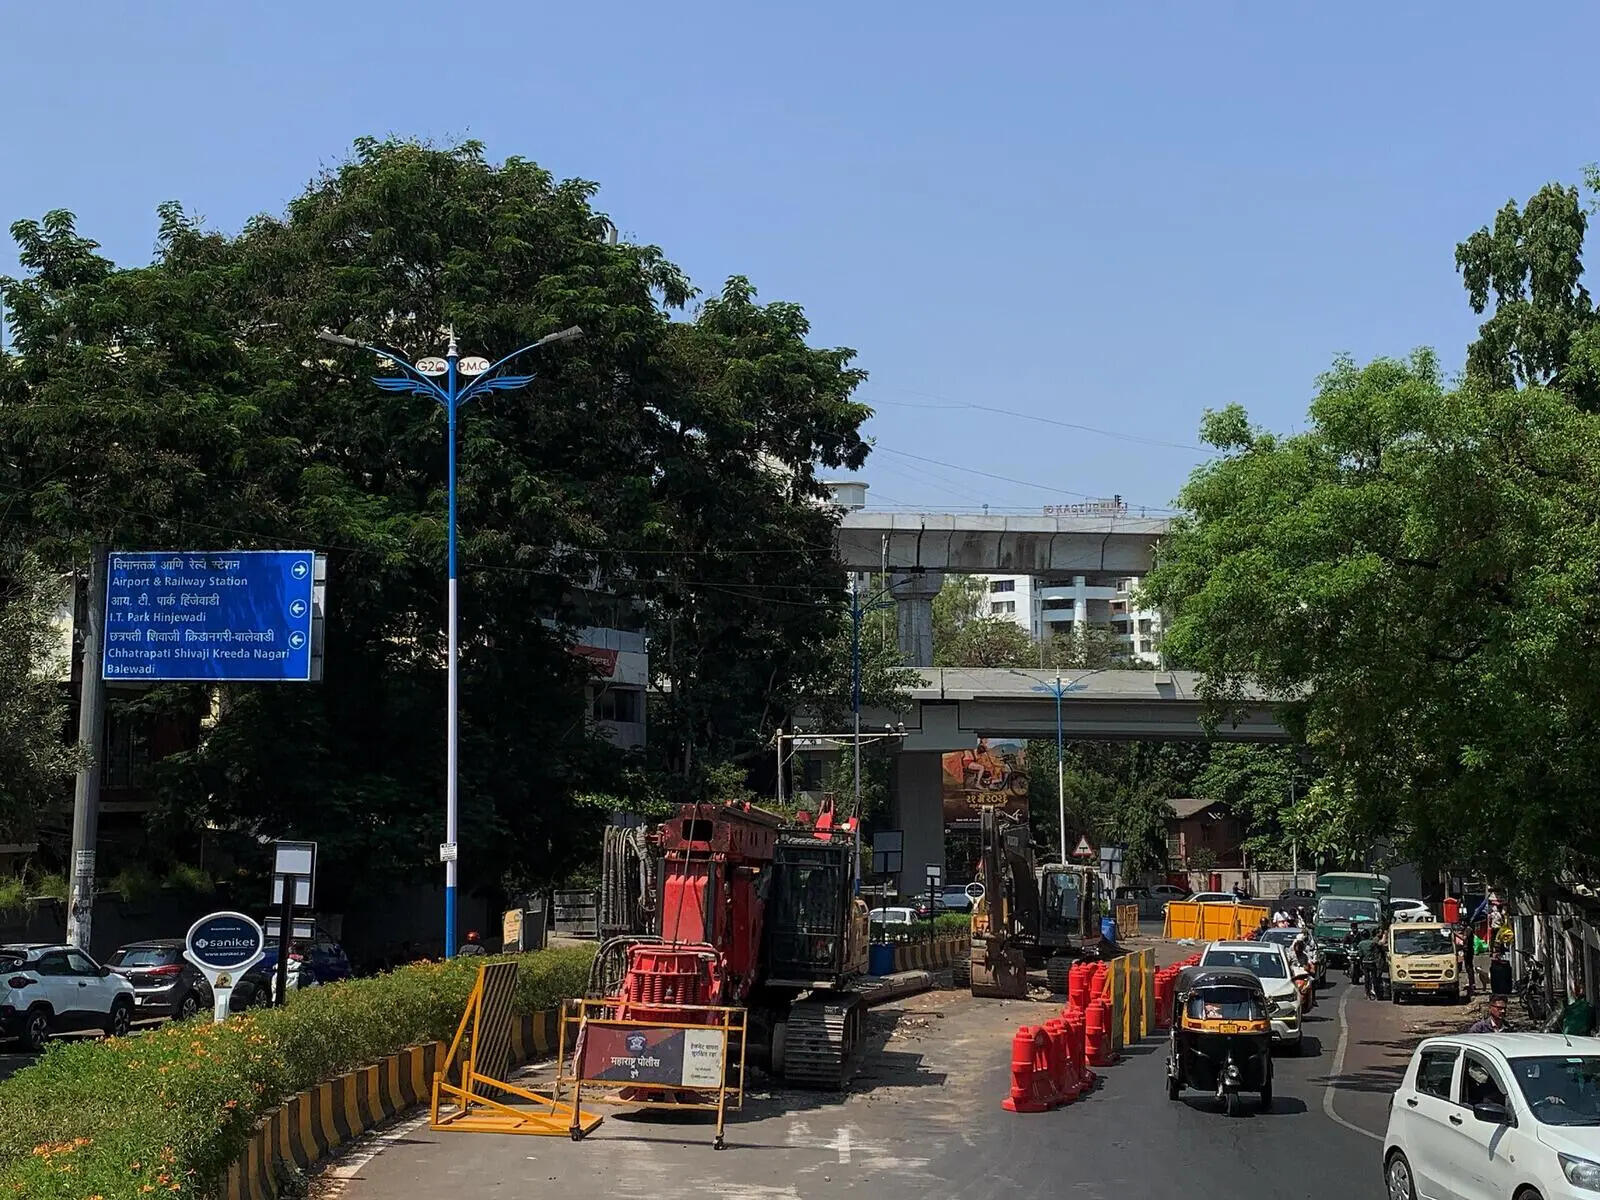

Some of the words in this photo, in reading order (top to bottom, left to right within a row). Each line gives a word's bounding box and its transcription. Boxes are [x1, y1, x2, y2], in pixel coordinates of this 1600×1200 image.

[113, 557, 156, 570] विमानतळ
[161, 557, 184, 570] आणि
[112, 576, 150, 588] Airport
[153, 576, 161, 586] &
[165, 576, 206, 588] Railway
[209, 576, 248, 586] Station
[138, 592, 151, 606] टी.
[157, 592, 176, 606] पार्क
[110, 612, 124, 622] I.T.
[127, 611, 150, 622] Park
[153, 611, 206, 625] Hinjewadi
[109, 628, 142, 642] छत्रपती
[146, 628, 180, 642] शिवाजी
[108, 648, 171, 660] Chhatrapati
[174, 648, 209, 660] Shivaji
[213, 648, 250, 659] Kreeda
[253, 648, 290, 661] Nagari
[107, 664, 155, 674] Balewadi
[209, 938, 255, 947] saniket
[610, 1056, 636, 1069] महाराष्ट्र
[637, 1055, 661, 1068] पोलीस
